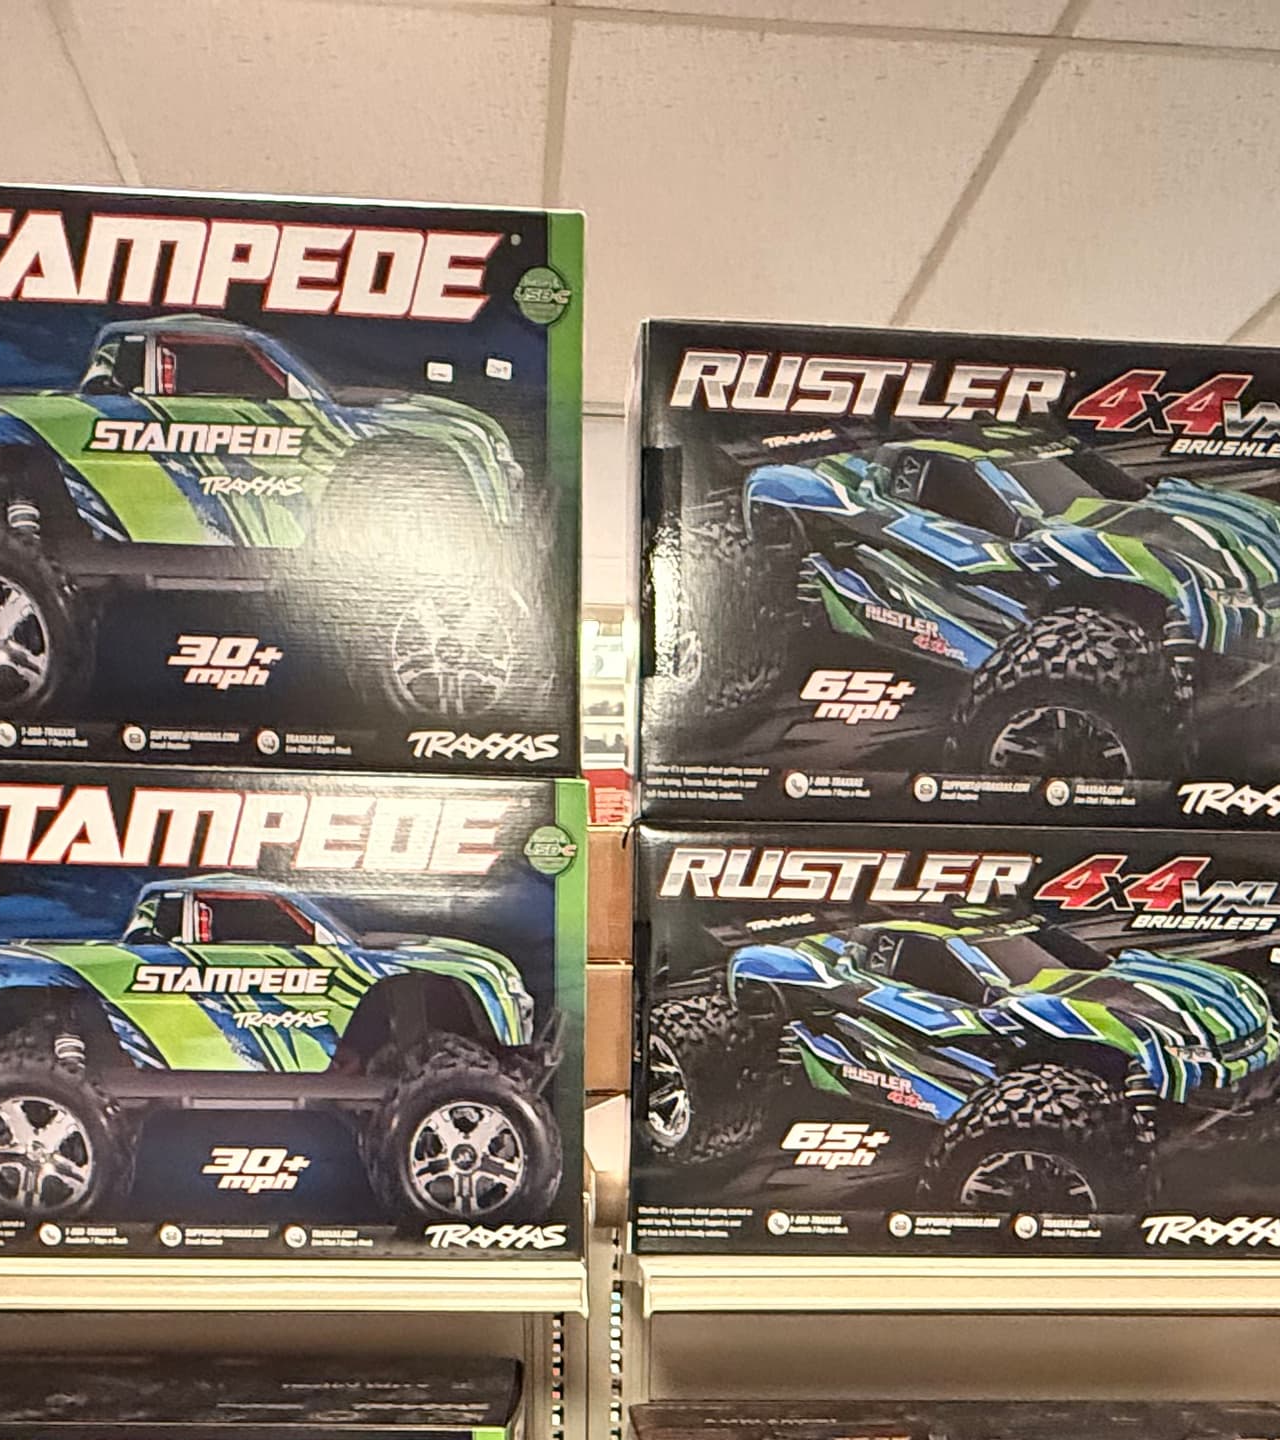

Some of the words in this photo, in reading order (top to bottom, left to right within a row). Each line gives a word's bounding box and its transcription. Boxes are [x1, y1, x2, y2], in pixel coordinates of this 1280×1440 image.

[669, 349, 1072, 421] RUSTLER
[89, 418, 307, 456] STAMPEDE
[198, 475, 303, 497] TRAXXAS
[864, 604, 942, 637] RUSTLER
[167, 635, 283, 670] 30+
[184, 662, 269, 691] mph
[800, 670, 916, 704] 65+
[814, 698, 901, 724] mph
[407, 730, 561, 762] TRAXXAS
[658, 846, 1037, 904] RUSTLER
[1131, 914, 1277, 932] BRUSHLESS
[131, 964, 332, 994] STAMPEDE
[232, 1010, 329, 1028] TRAXXAS
[842, 1064, 913, 1093] RUSTLER
[781, 1122, 892, 1153] 65+
[202, 1147, 311, 1175] 30+
[795, 1148, 875, 1171] mph
[218, 1171, 298, 1195] mph
[425, 1223, 568, 1250] TRAXXAS
